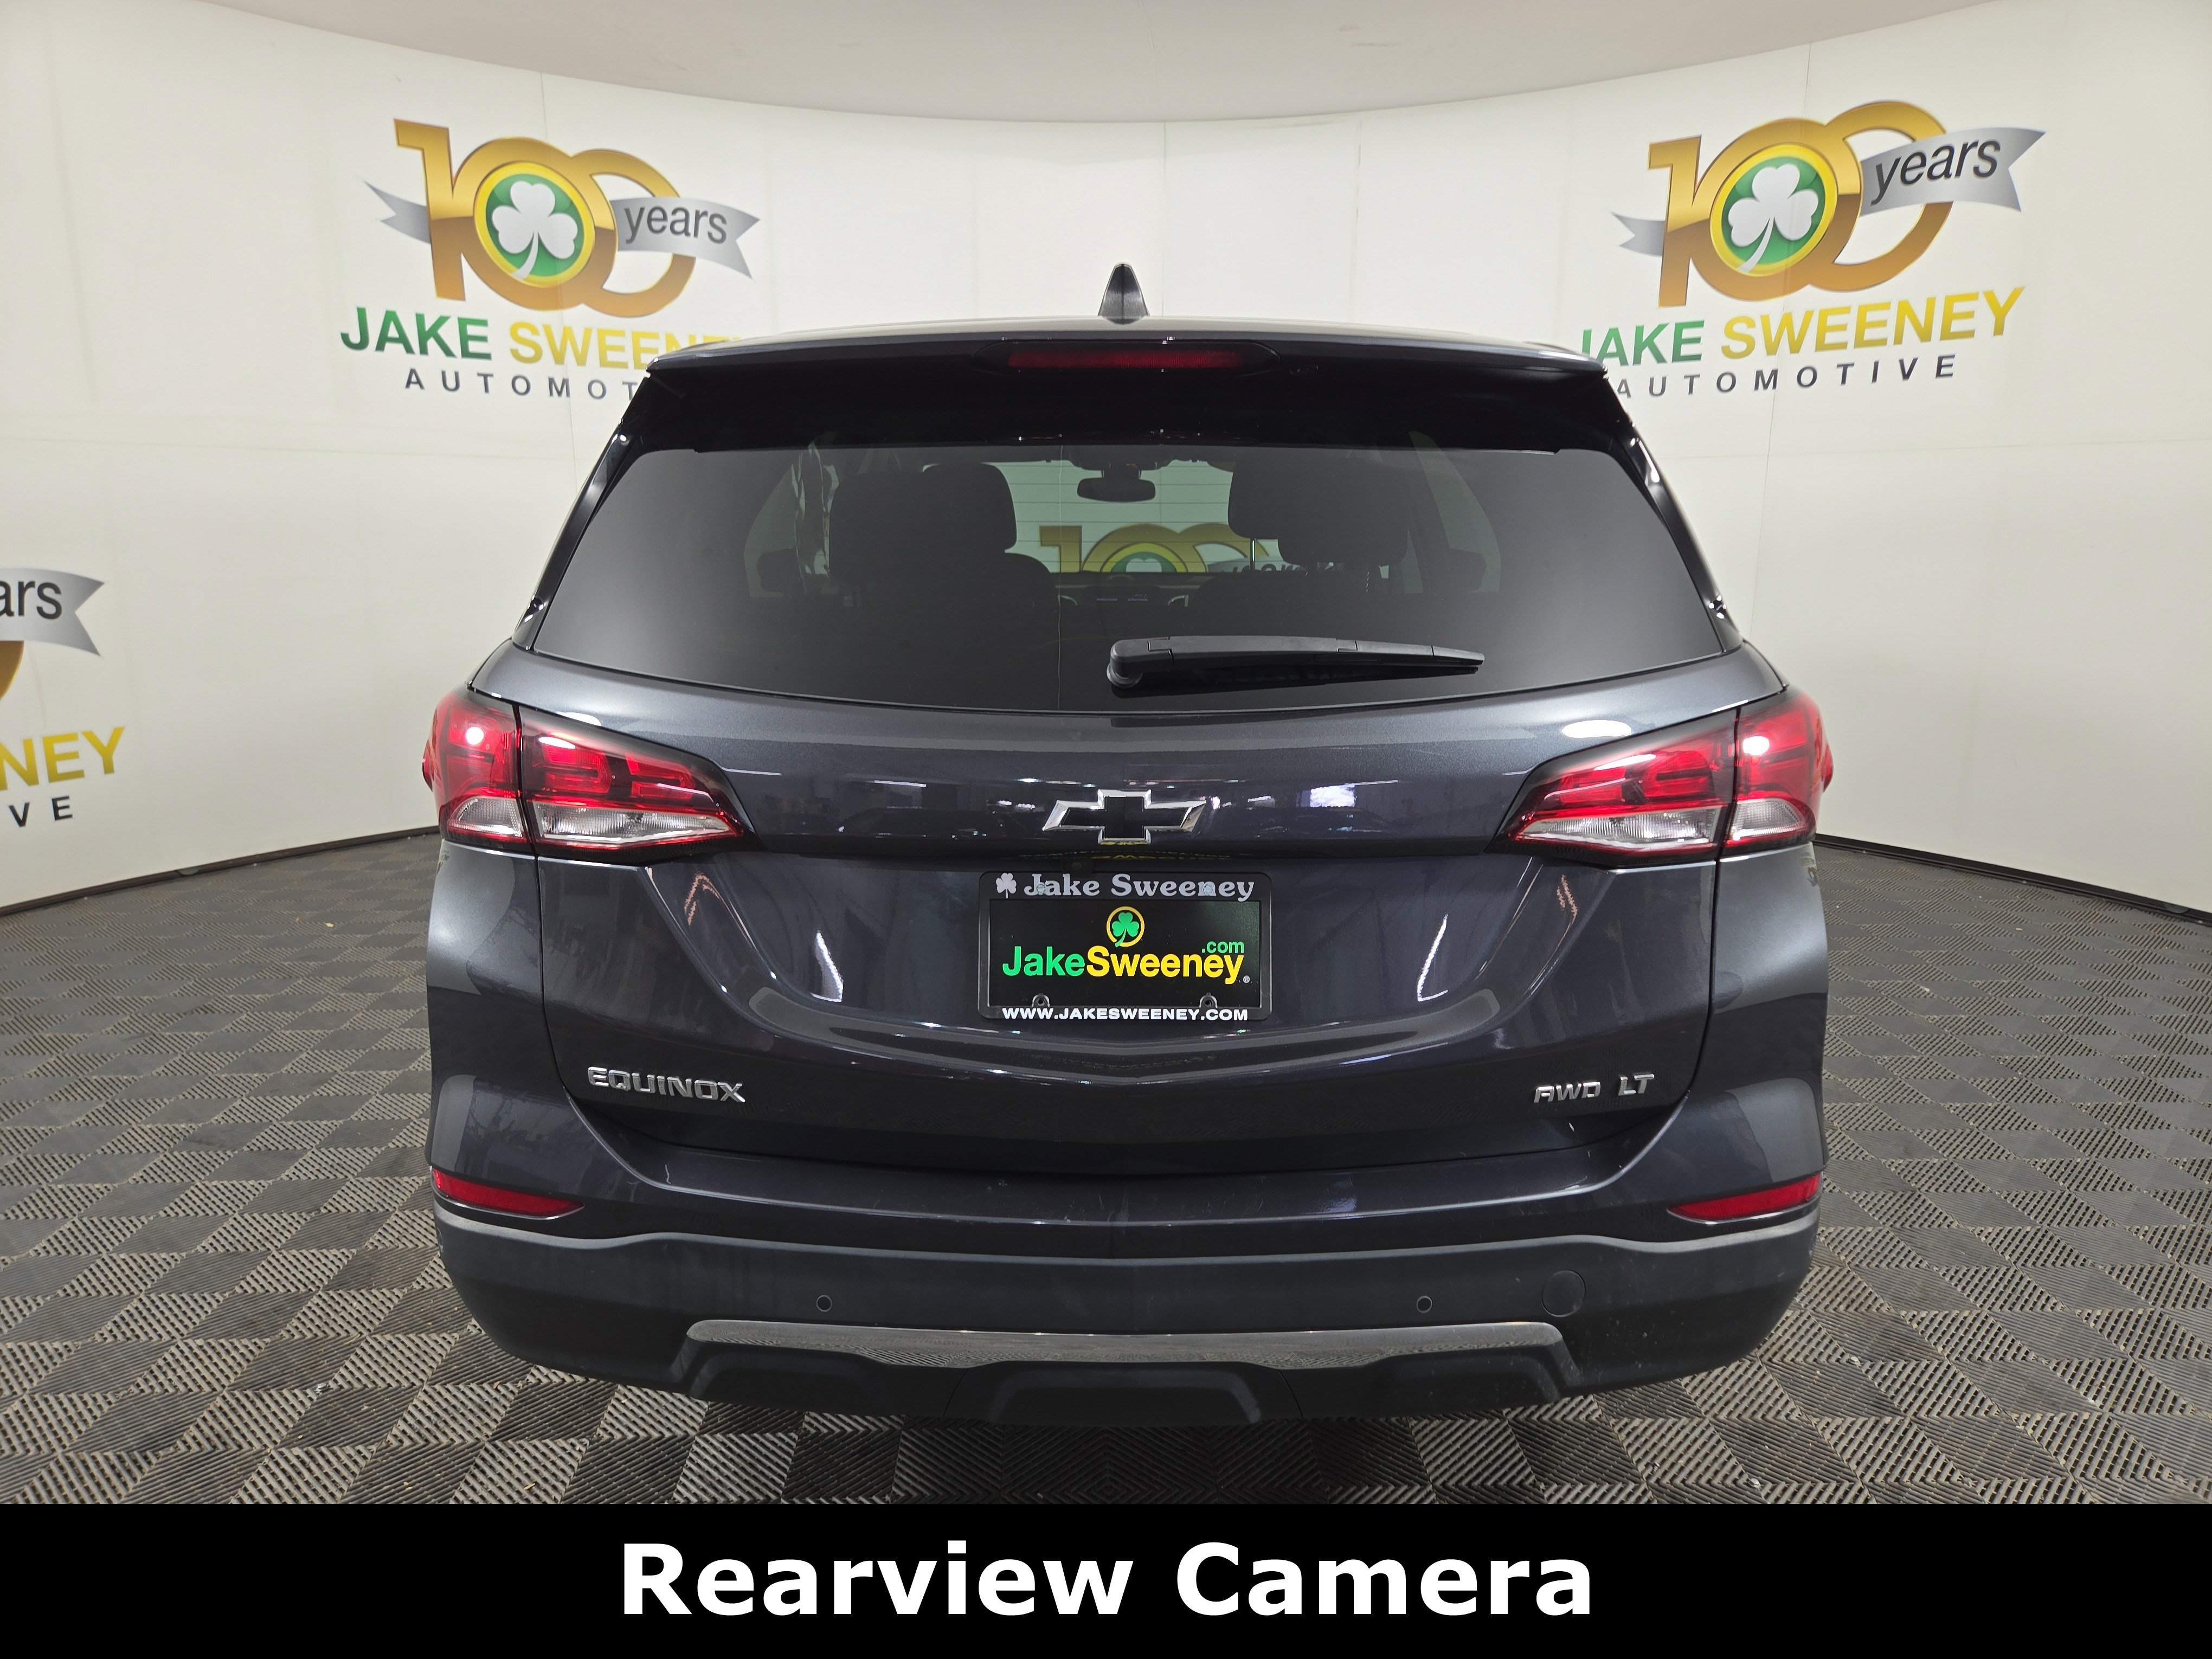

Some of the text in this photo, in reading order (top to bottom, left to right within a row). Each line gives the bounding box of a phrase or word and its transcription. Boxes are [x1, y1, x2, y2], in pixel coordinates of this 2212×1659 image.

[394, 118, 728, 317] 100 years
[1649, 100, 2001, 307] 100 years
[340, 307, 741, 370] JAKE SWEE
[1721, 286, 2026, 359] SWEENEY
[405, 368, 638, 400] AUTOMOT
[1617, 353, 1956, 399] AUTOMOTIVE
[1024, 873, 1255, 902] Jake Sweeney
[1002, 945, 1244, 985] JakeSweeney
[1201, 941, 1245, 954] .com
[1002, 1008, 1248, 1020] WWW.JAKESWEENEY.COM
[588, 1066, 745, 1103] EQUINOX
[1534, 1073, 1654, 1103] AWD LT
